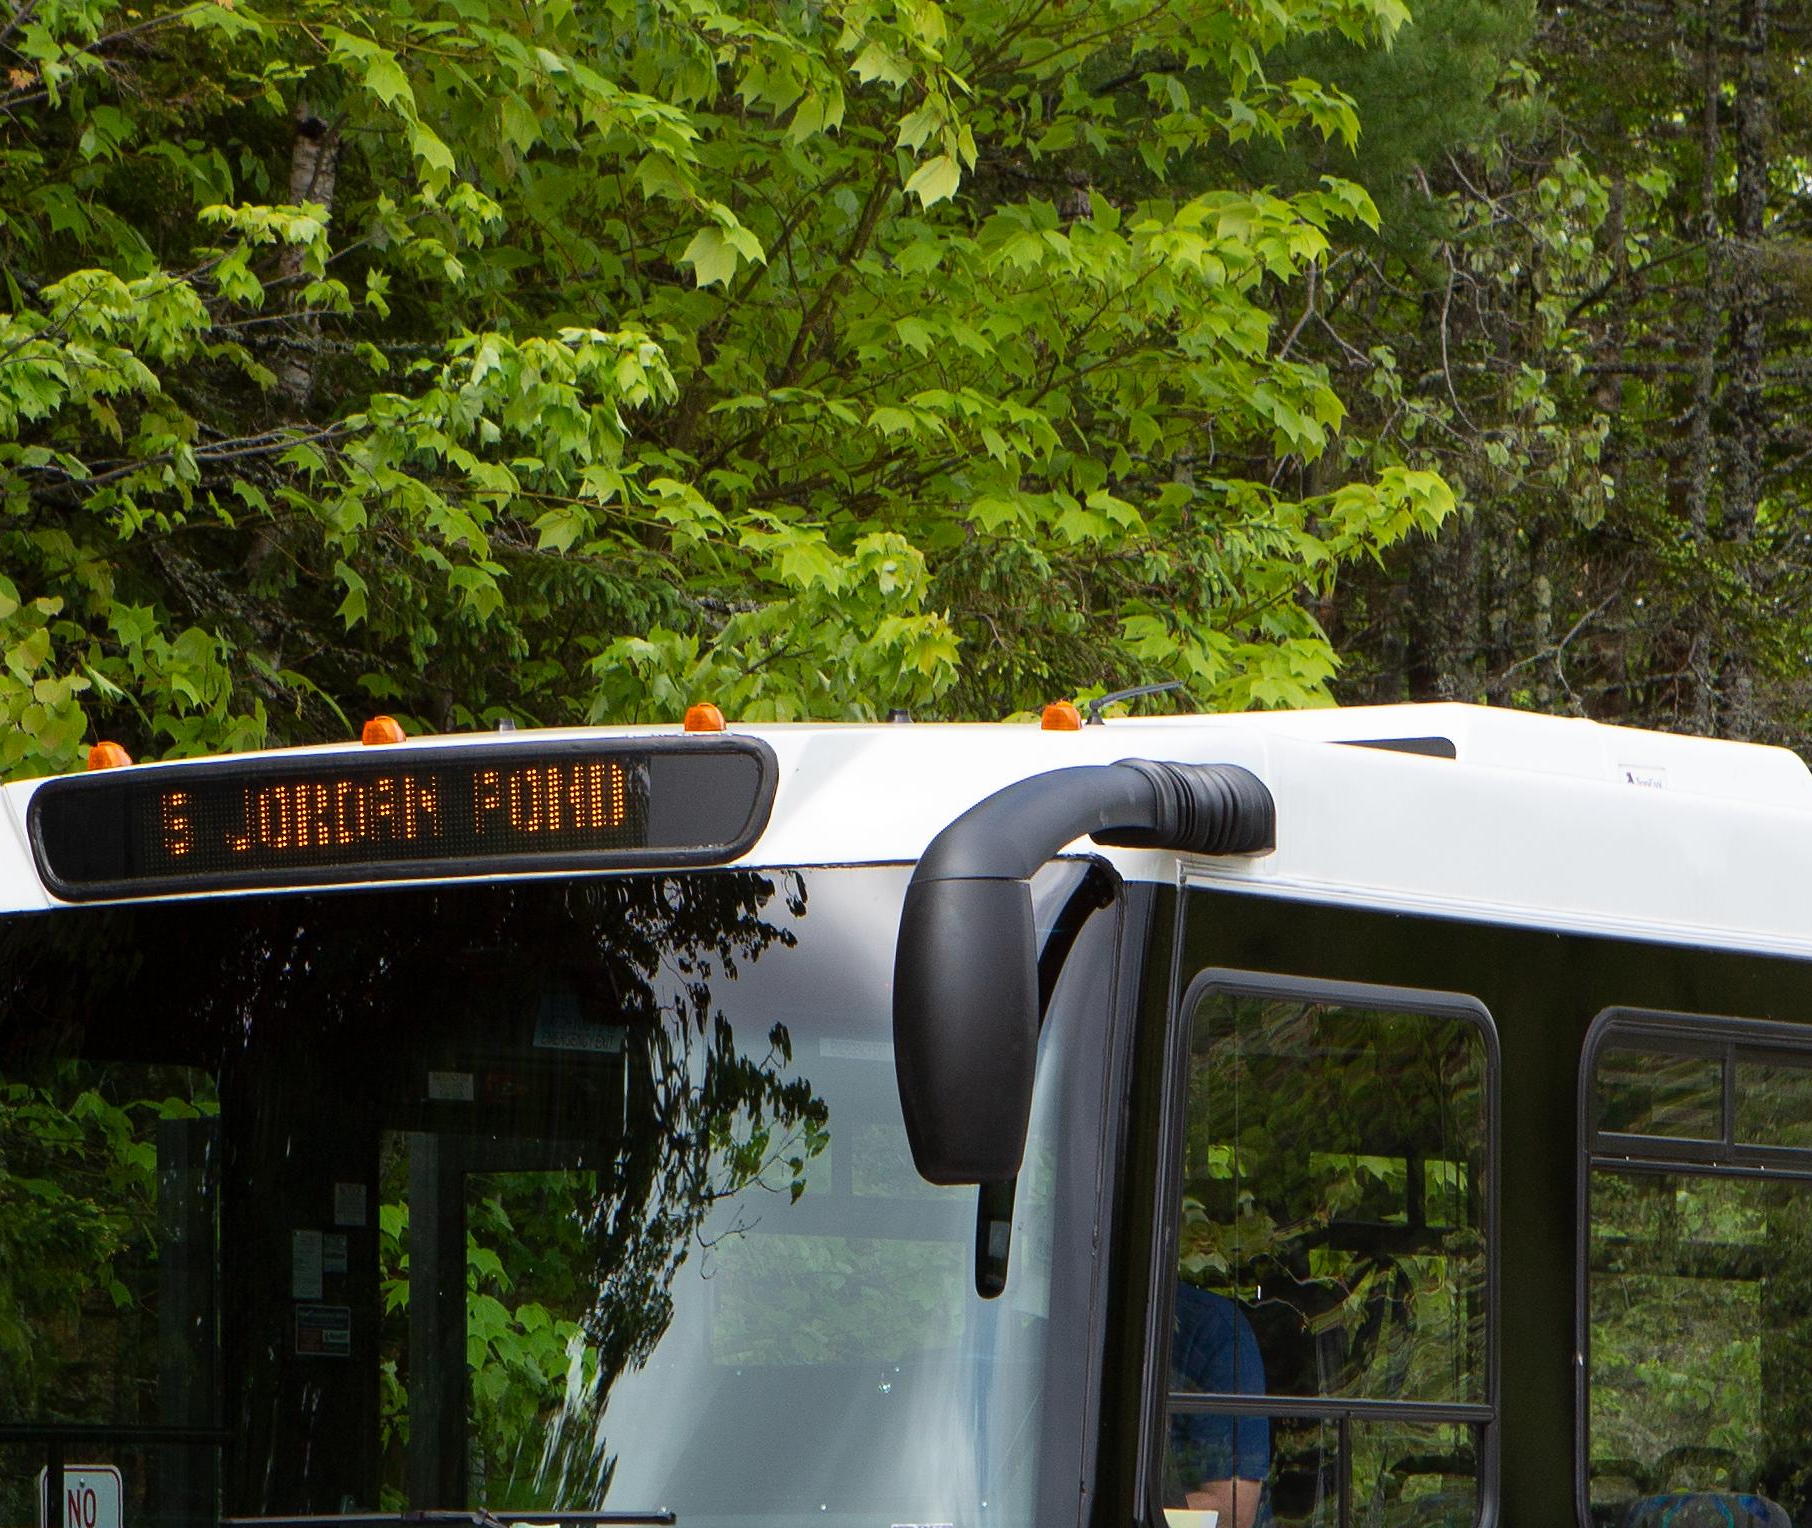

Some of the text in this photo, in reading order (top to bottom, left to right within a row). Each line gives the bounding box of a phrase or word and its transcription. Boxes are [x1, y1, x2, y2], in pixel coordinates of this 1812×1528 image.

[225, 775, 443, 850] JORDAN
[473, 763, 625, 836] POND
[67, 1488, 96, 1528] NO
